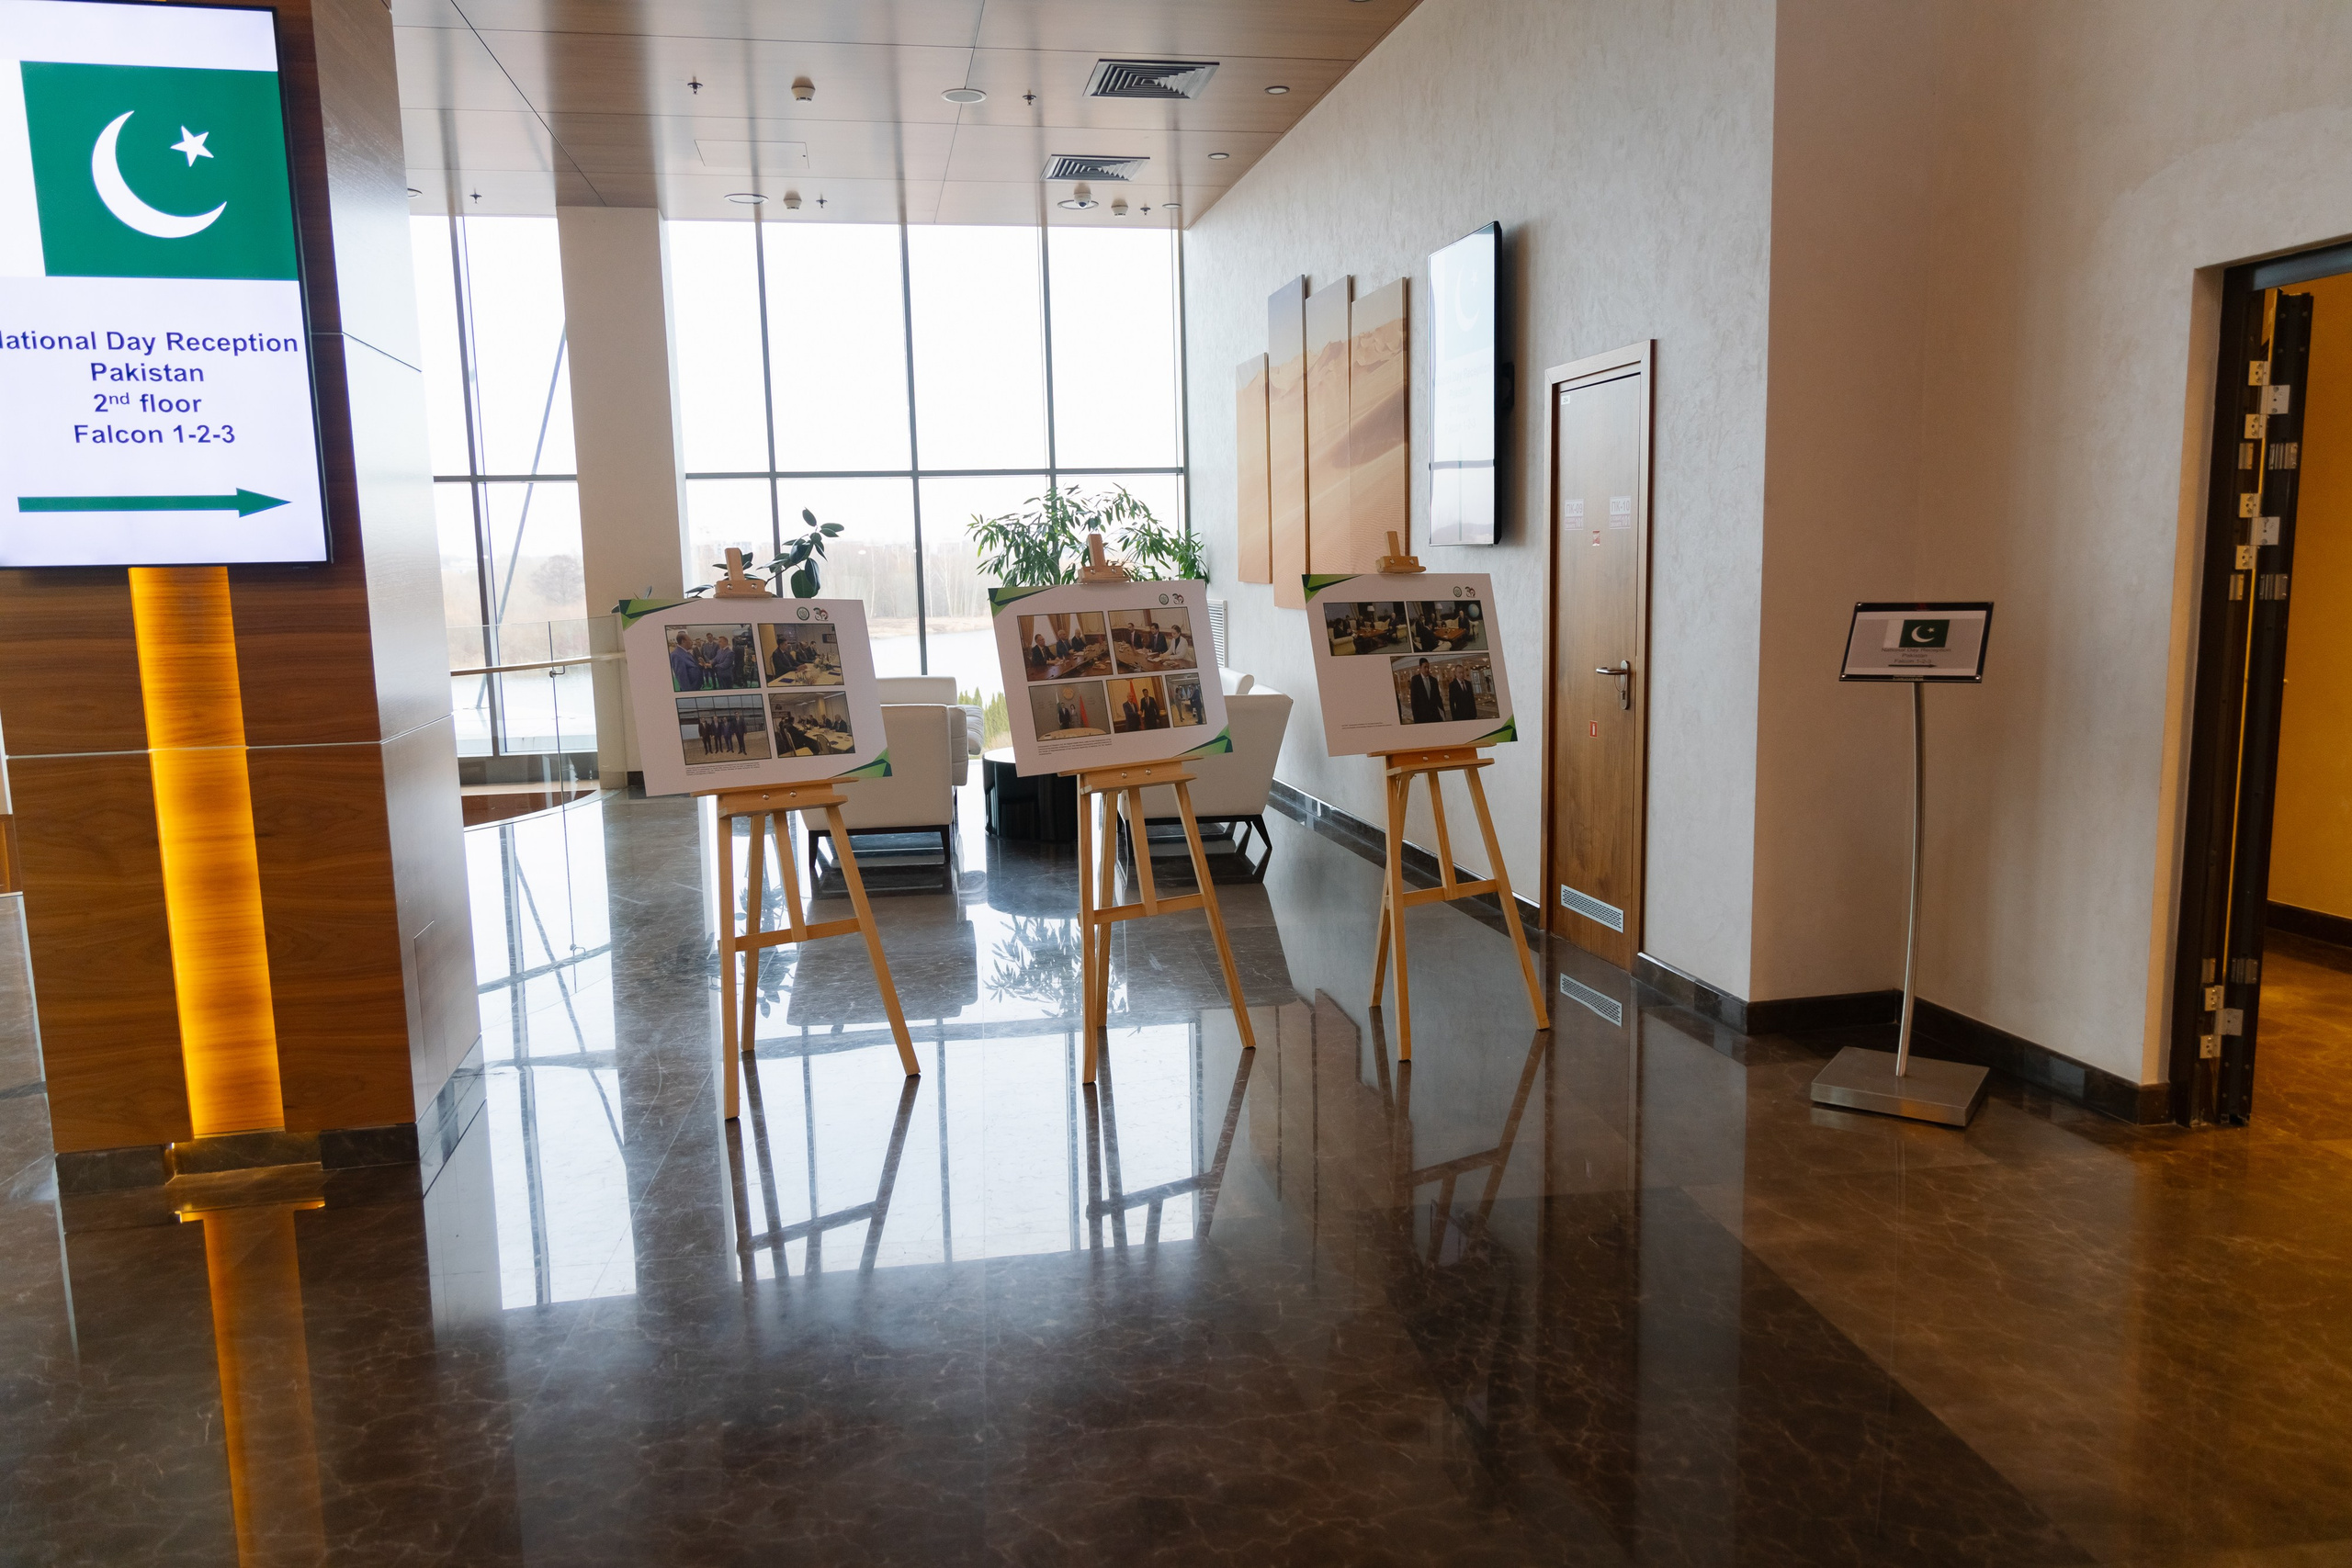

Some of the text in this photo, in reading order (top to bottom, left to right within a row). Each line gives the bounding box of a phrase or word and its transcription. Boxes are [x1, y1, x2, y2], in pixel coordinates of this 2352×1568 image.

[0, 331, 298, 356] ational Day Reception
[91, 363, 204, 382] Pakistan
[94, 392, 201, 412] 2nd floor
[74, 425, 235, 443] Falcon 1-2-3
[1566, 503, 1583, 514] ПК-09
[1611, 501, 1631, 513] ПК-10
